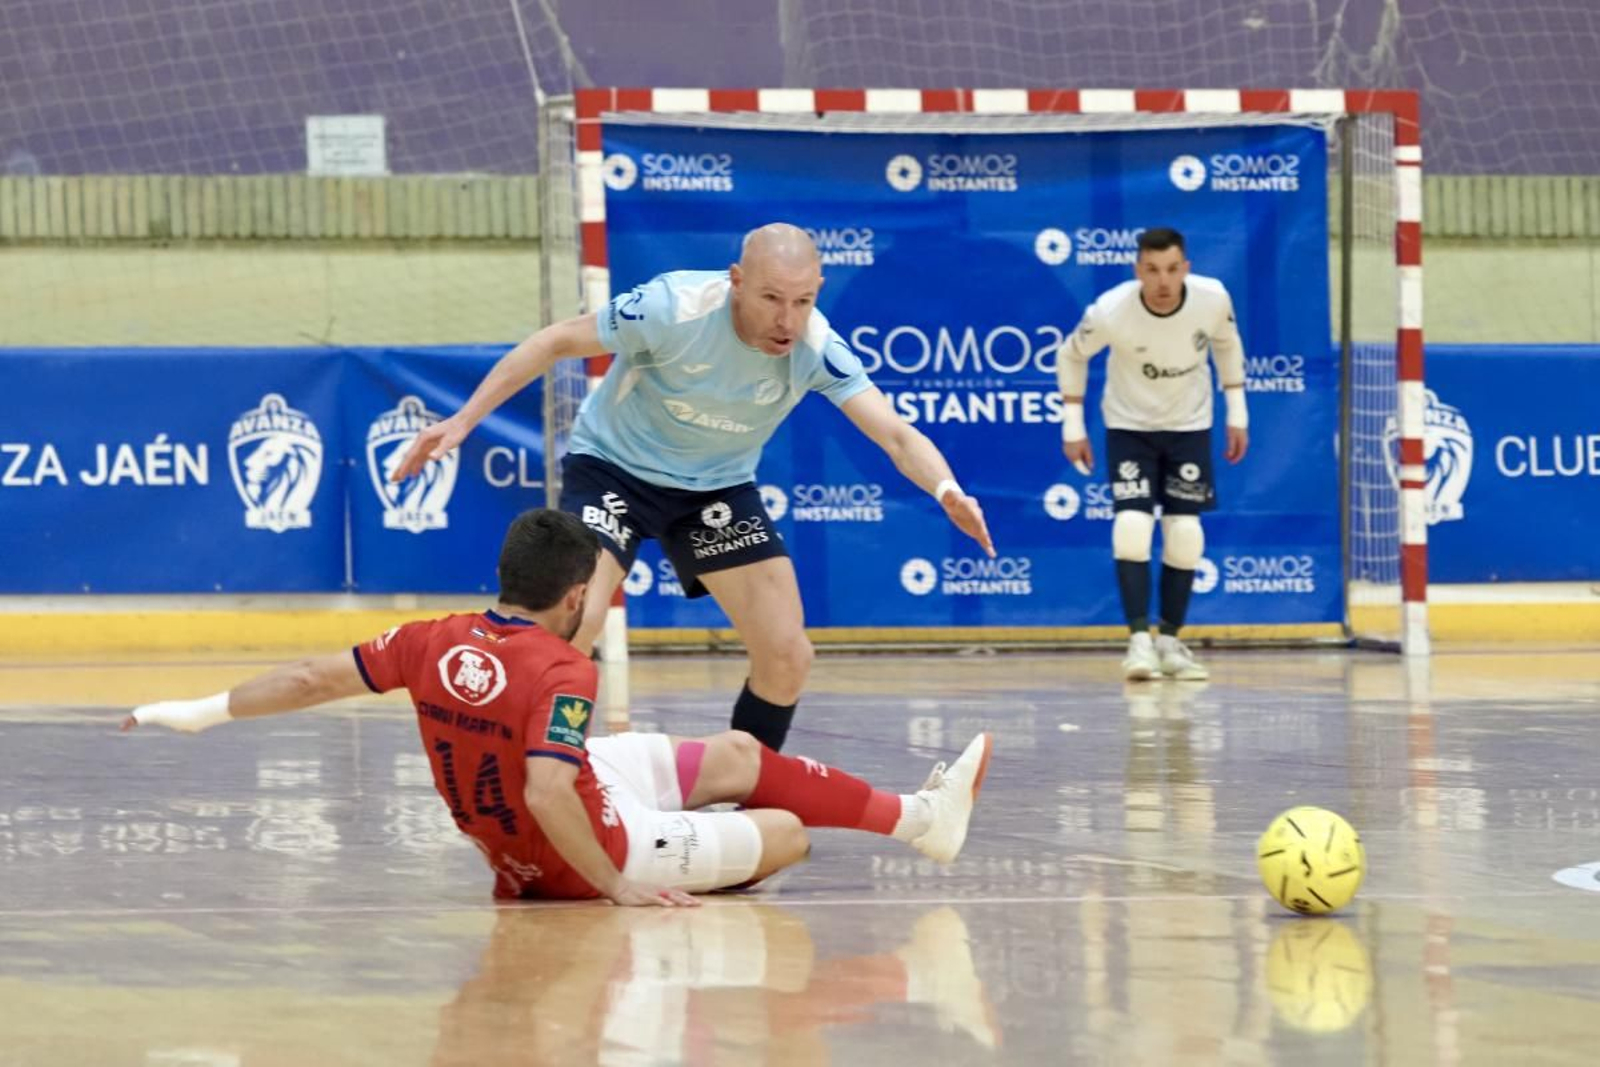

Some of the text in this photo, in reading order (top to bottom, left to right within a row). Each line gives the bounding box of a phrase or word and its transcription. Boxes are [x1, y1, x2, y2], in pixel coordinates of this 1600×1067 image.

[643, 176, 733, 191] INSTANTES
[928, 176, 1018, 192] INSTANTES
[1212, 176, 1299, 191] INSTANTES
[1077, 250, 1138, 265] INSTAN
[886, 391, 1064, 423] STANTES
[229, 413, 322, 442] AVANZA
[79, 433, 209, 486] JAÉN
[793, 506, 884, 521] INSTANTES
[693, 531, 770, 560] INSTANTES
[942, 580, 1032, 595] INSTANTES
[1225, 578, 1315, 593] INSTANTES
